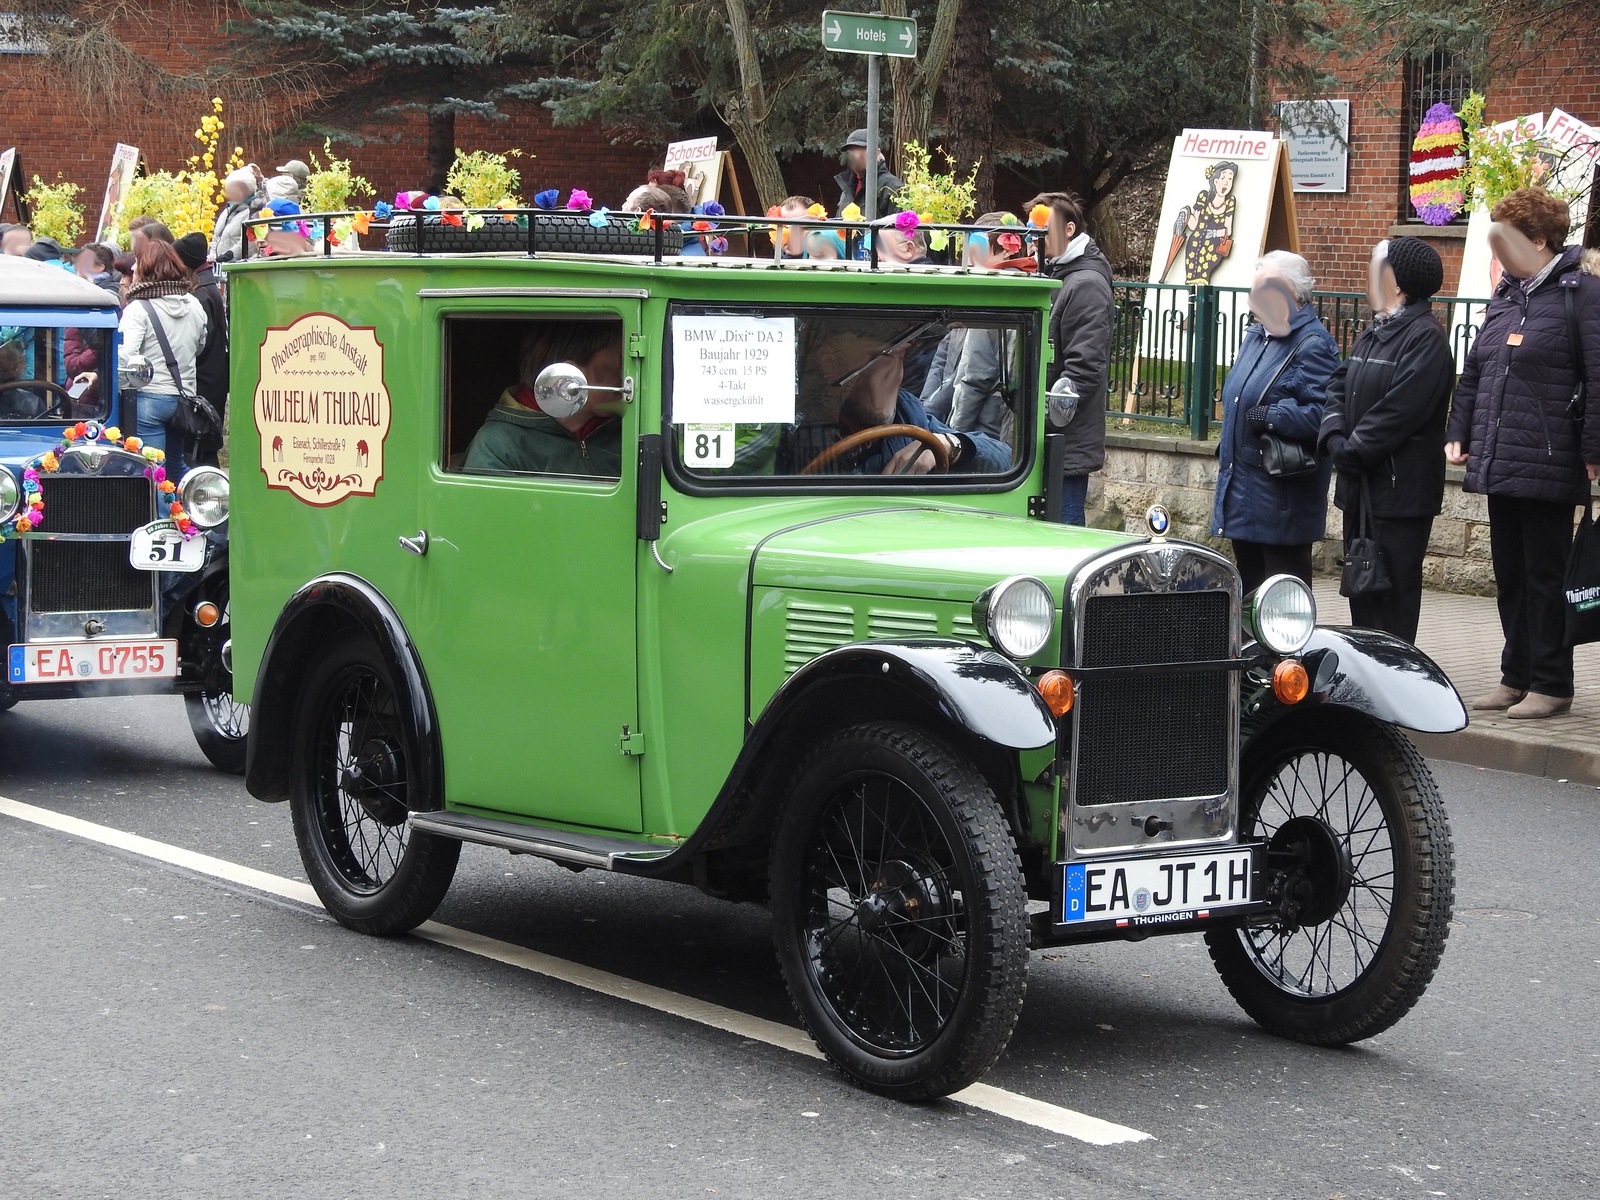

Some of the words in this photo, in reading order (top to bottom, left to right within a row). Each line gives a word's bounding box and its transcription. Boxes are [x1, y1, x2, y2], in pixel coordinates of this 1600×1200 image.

[857, 27, 886, 42] Hotels
[667, 140, 715, 162] Schorsch
[1183, 133, 1266, 155] Hermine
[684, 329, 716, 342] BMW
[757, 330, 775, 343] DA
[777, 330, 784, 343] 2
[271, 325, 338, 374] Photographische
[339, 333, 368, 376] Anstalt
[700, 347, 741, 363] Baujahr
[744, 348, 770, 361] 1929
[701, 365, 717, 376] 743
[719, 368, 737, 376] ccm
[743, 365, 753, 376] 15
[755, 365, 768, 376] PS
[718, 380, 746, 391] 4-Takt
[261, 389, 319, 425] WILHELM
[322, 391, 381, 428] THURAU
[703, 395, 764, 408] wassergekühlt
[342, 438, 346, 451] 9
[695, 433, 721, 459] 81
[325, 453, 336, 464] 1028
[149, 540, 184, 562] 51
[37, 648, 74, 677] EA
[14, 667, 21, 676] D
[1086, 868, 1130, 913] EA
[1071, 898, 1079, 912] D
